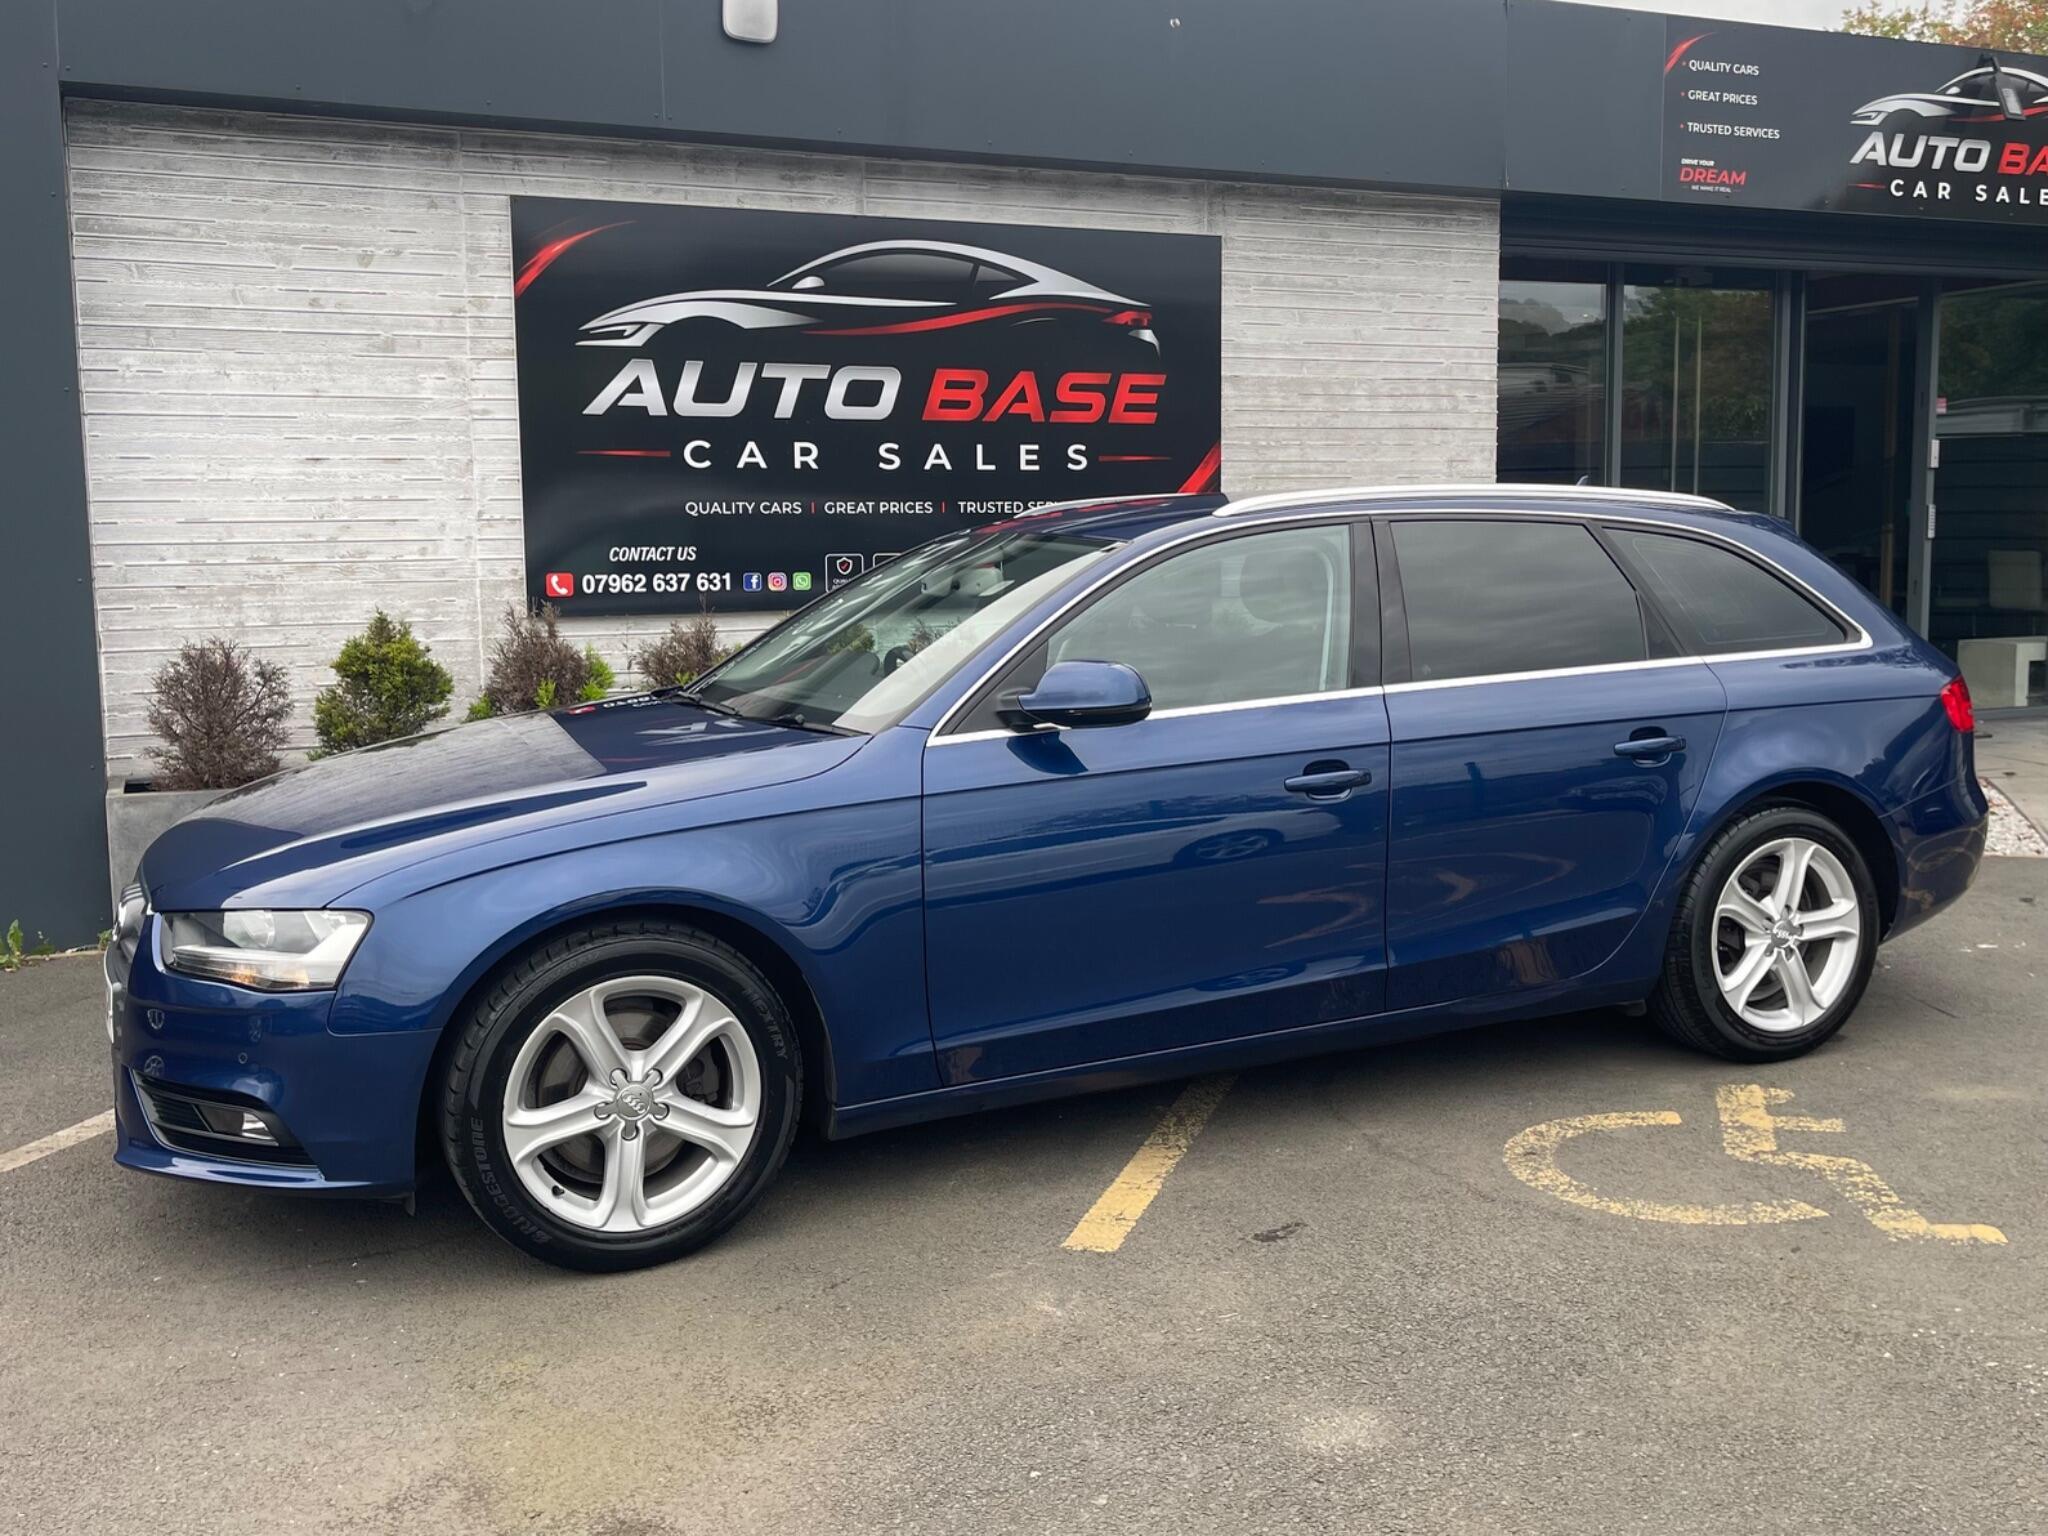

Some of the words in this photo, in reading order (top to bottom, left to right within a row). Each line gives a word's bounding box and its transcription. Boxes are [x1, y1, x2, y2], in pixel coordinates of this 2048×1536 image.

[1688, 60, 1731, 73] QUALITY
[1733, 64, 1760, 76] CARS
[1687, 90, 1721, 103] GREAT
[1722, 93, 1758, 106] PRICES
[1687, 122, 1732, 136] TRUSTED
[1734, 126, 1780, 139] SERVICES
[1849, 131, 1991, 172] AUTO
[1679, 167, 1747, 185] DREAM
[1889, 179, 1951, 200] CAR
[582, 358, 902, 421] AUTO
[921, 367, 1167, 424] BASE
[683, 440, 819, 470] CAR
[878, 442, 1088, 470] SALES
[685, 501, 755, 517] QUALITY
[759, 501, 802, 515] CARS
[824, 501, 875, 514] GREAT
[879, 501, 933, 514] PRICES
[957, 501, 1024, 514] TRUSTED
[609, 546, 676, 562] CONTACT
[677, 546, 697, 561] US
[581, 574, 647, 594] 07962
[652, 573, 691, 592] 637
[696, 572, 732, 592] 631
[470, 1117, 553, 1244] BRIDGESTONE
